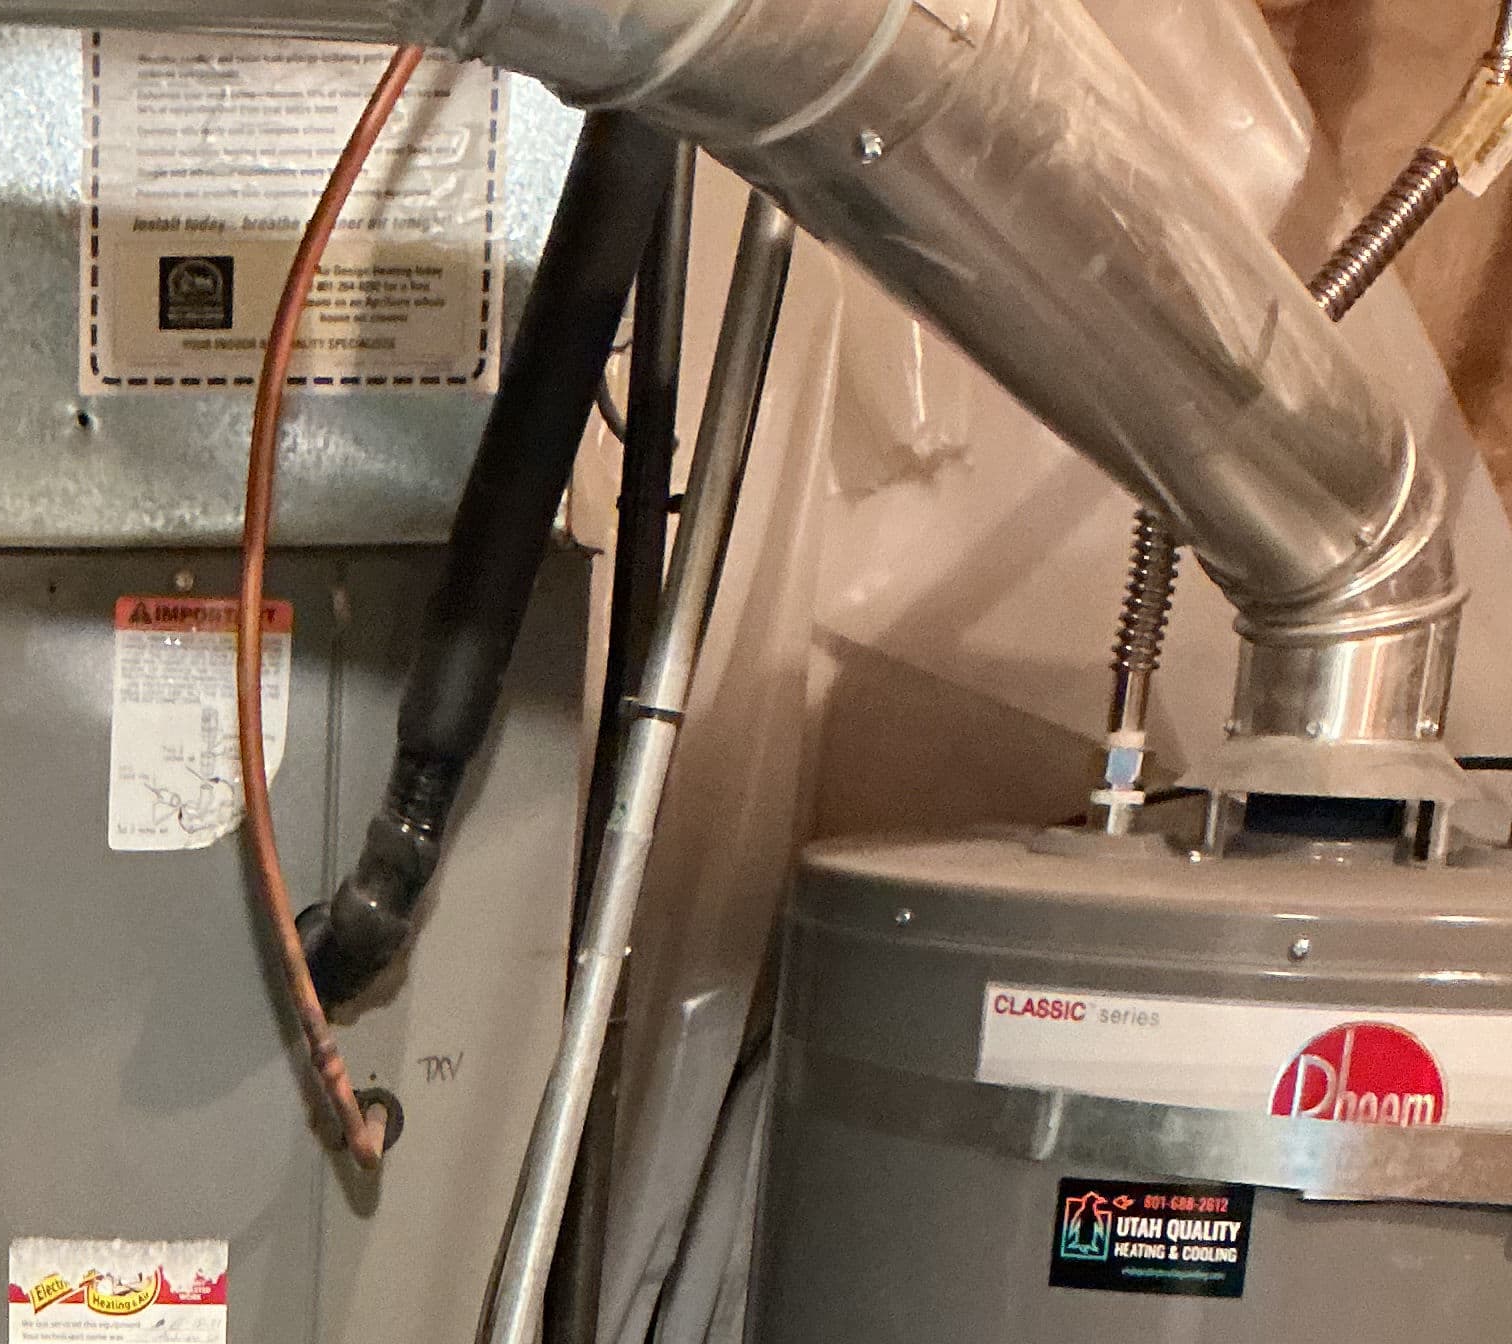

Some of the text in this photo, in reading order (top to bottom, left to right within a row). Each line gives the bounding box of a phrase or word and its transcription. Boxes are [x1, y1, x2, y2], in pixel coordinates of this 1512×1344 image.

[993, 993, 1160, 1028] CLASSIC series
[1116, 1216, 1242, 1242] UTAH QUALITY
[1114, 1242, 1237, 1263] HEATING & COOLING
[92, 1294, 131, 1311] Heating
